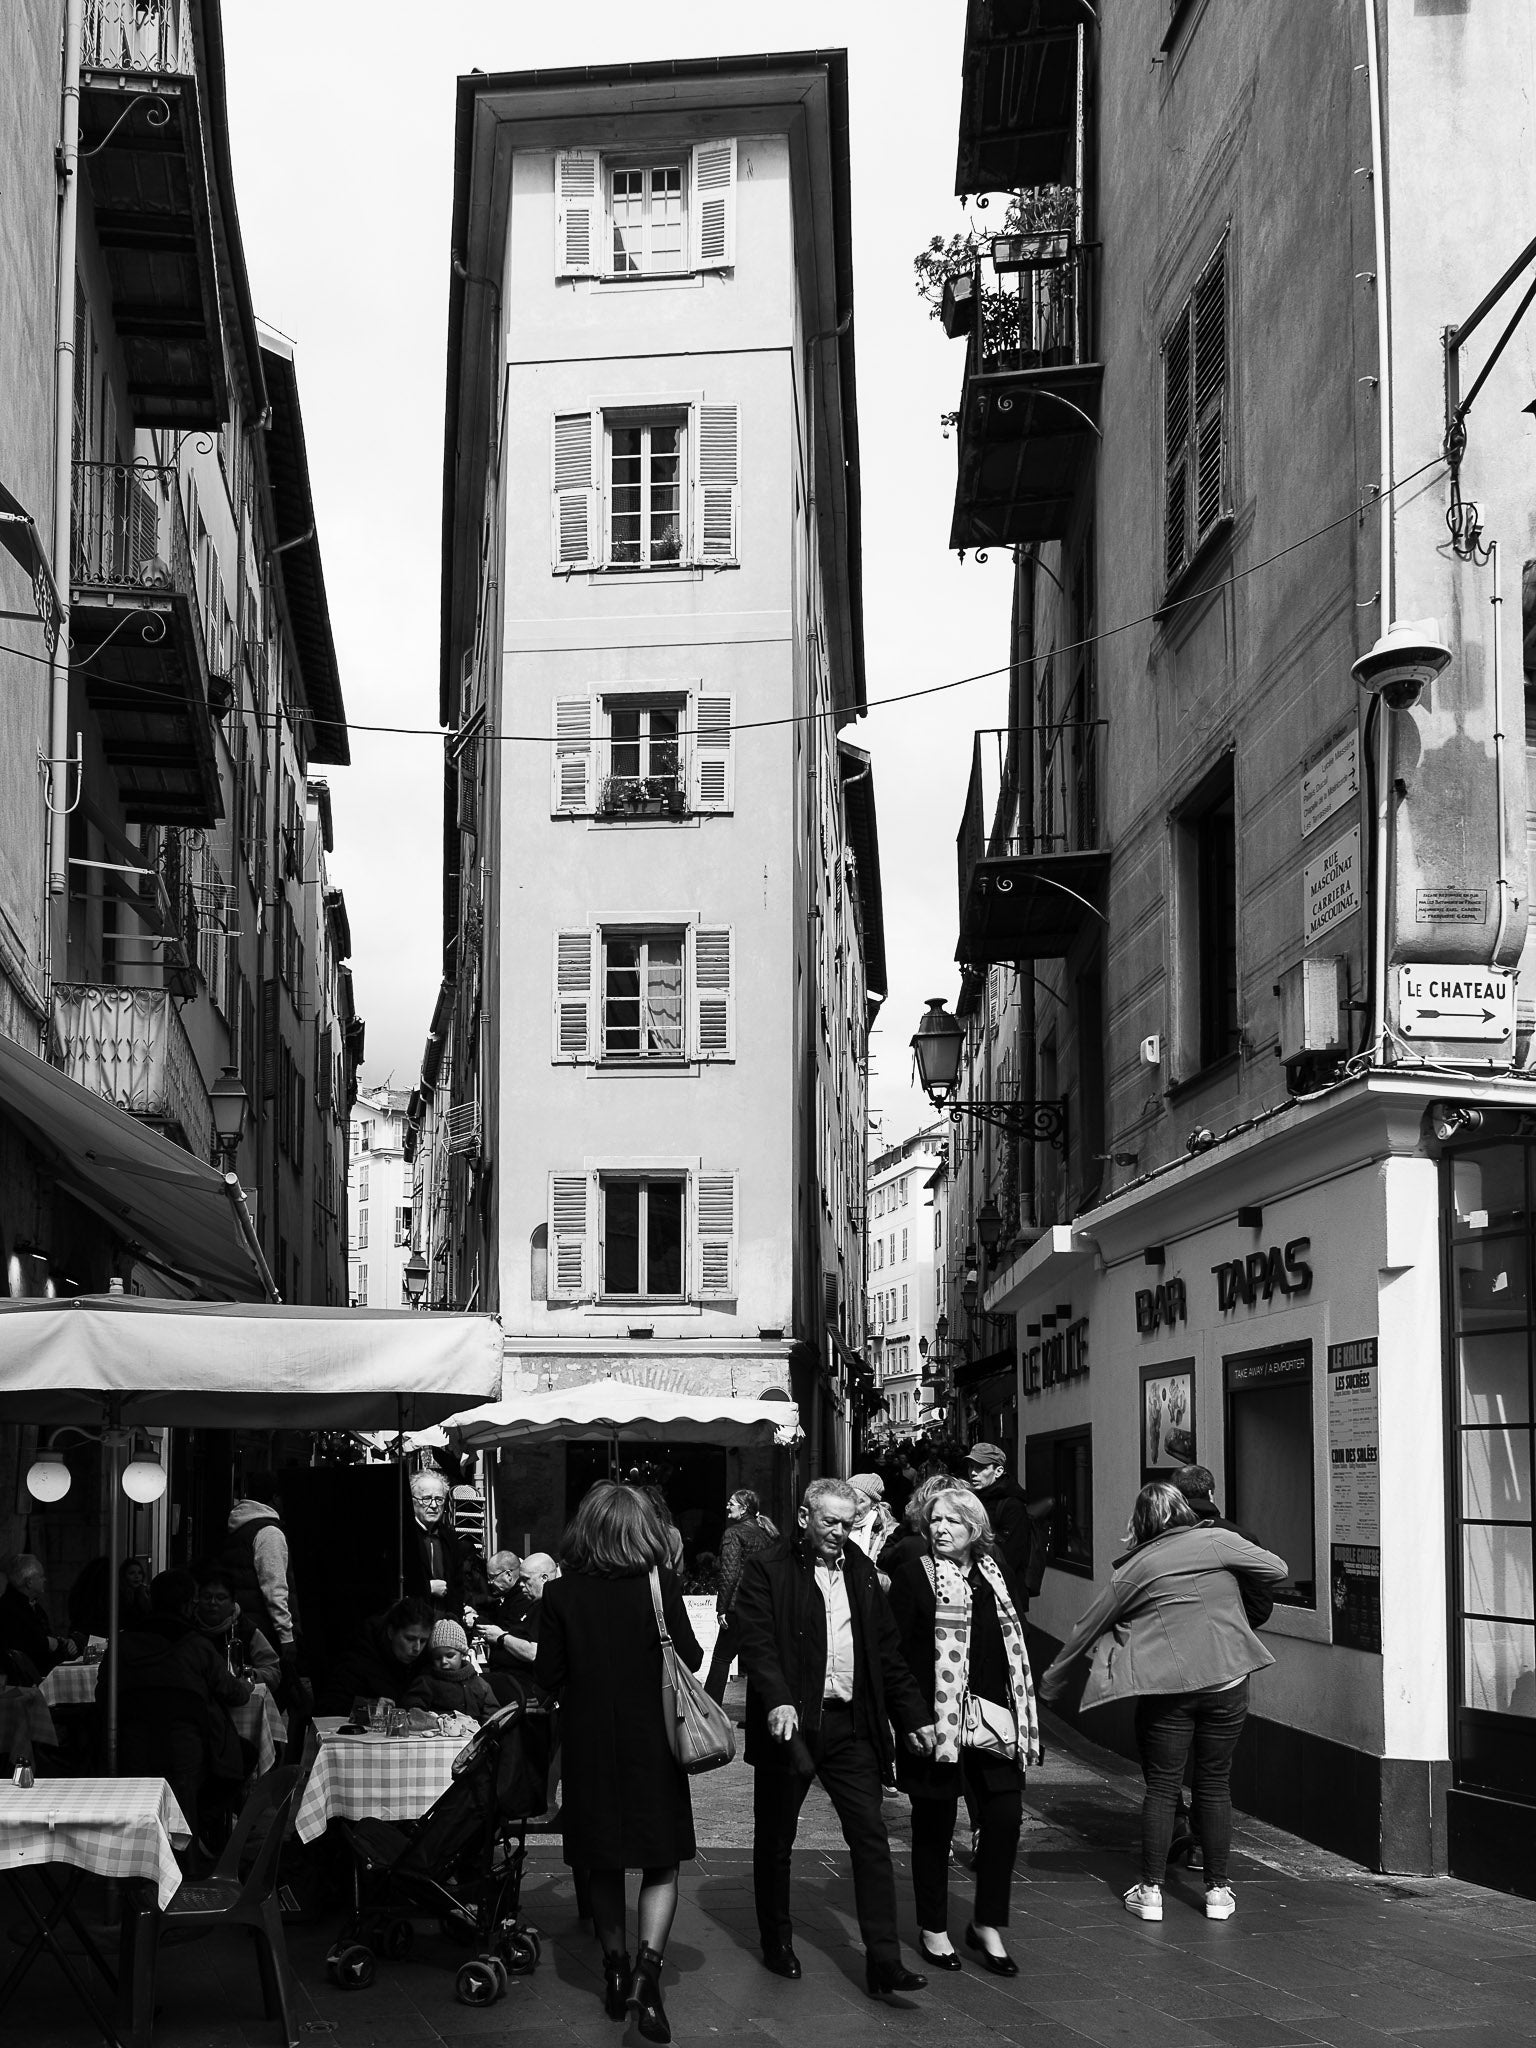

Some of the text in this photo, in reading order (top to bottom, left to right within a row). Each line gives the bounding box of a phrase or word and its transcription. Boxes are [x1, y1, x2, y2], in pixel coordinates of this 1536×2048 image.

[1323, 850, 1339, 872] RUE
[1310, 855, 1353, 898] MASCOÏNAT
[1312, 879, 1351, 916] CARRIERA
[1429, 980, 1506, 1000] CHATEAU
[1135, 1236, 1313, 1333] BAR TAPAS
[1332, 1341, 1373, 1369] LE KALICE
[1022, 1345, 1042, 1397] LE
[1234, 1368, 1248, 1379] TAKE
[1248, 1365, 1264, 1377] AWAY
[1273, 1357, 1305, 1373] EMPORTER
[1335, 1370, 1370, 1391] LES SUCRÉES
[1345, 1447, 1356, 1462] DES
[1356, 1444, 1378, 1462] SALÉES
[1356, 1547, 1379, 1564] GAUFRE
